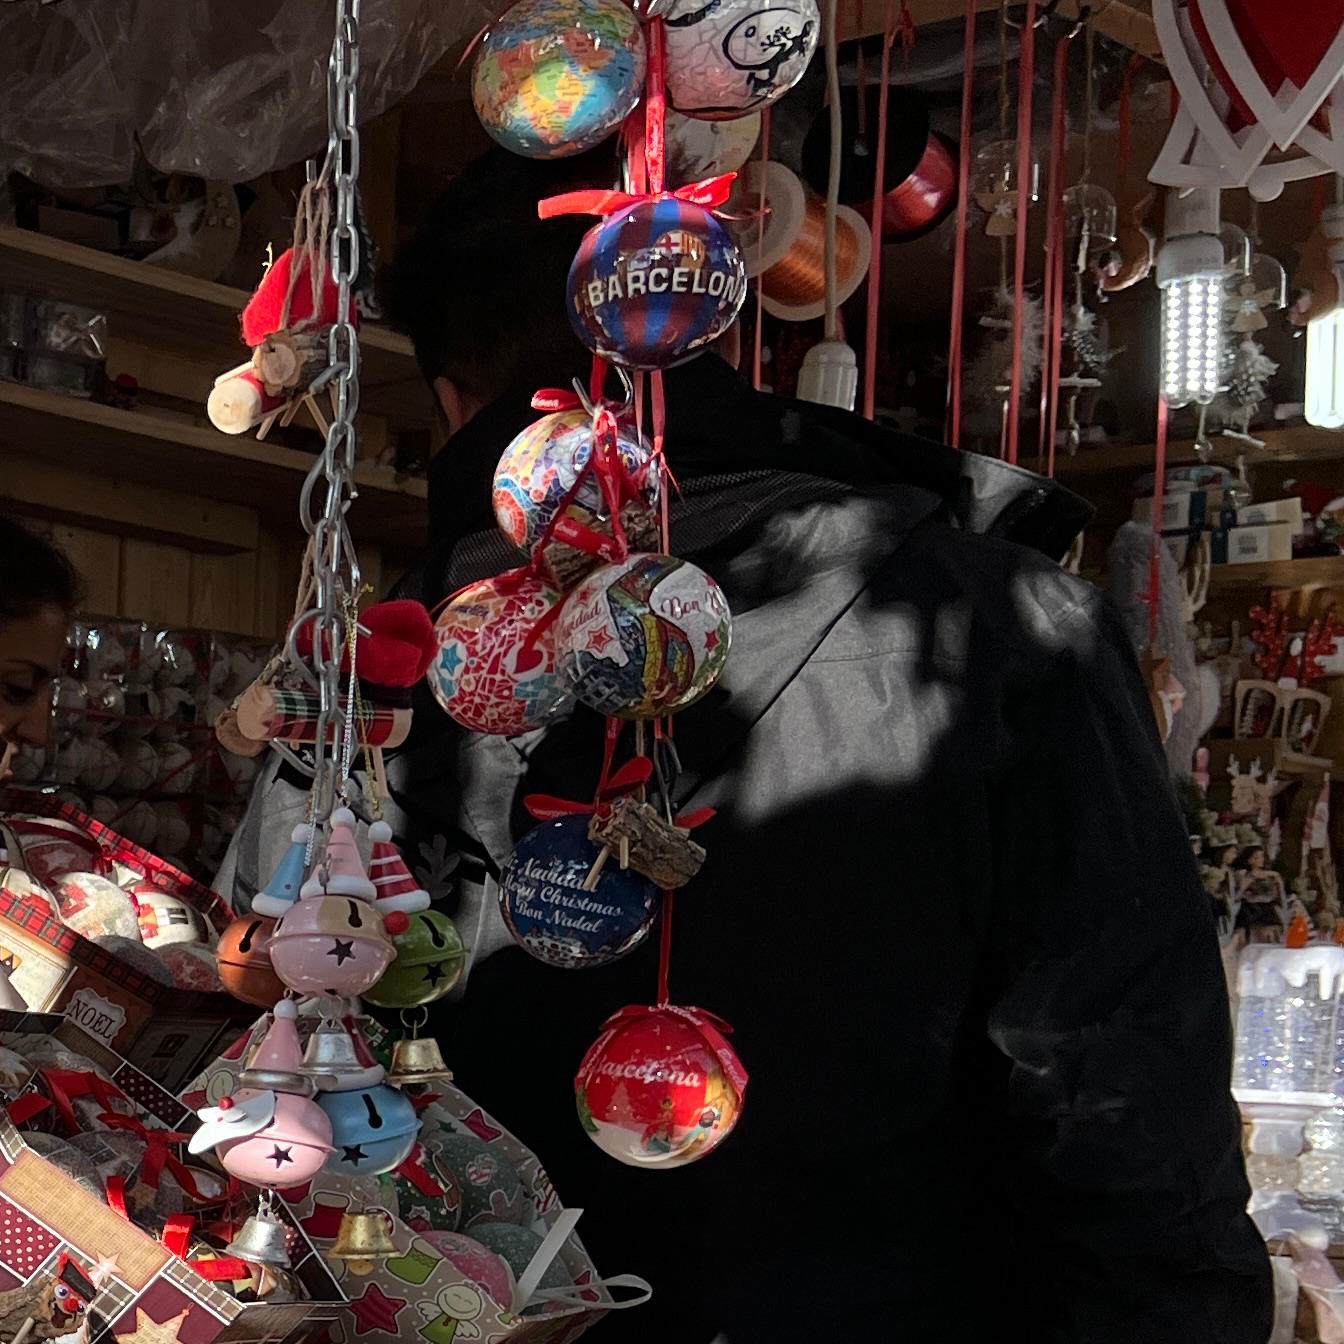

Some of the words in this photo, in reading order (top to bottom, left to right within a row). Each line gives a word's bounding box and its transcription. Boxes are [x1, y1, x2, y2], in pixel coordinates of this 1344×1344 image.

[540, 886, 622, 917] Christmas
[515, 902, 544, 920] Bon
[546, 909, 602, 934] Nadal
[66, 998, 116, 1039] NOEL
